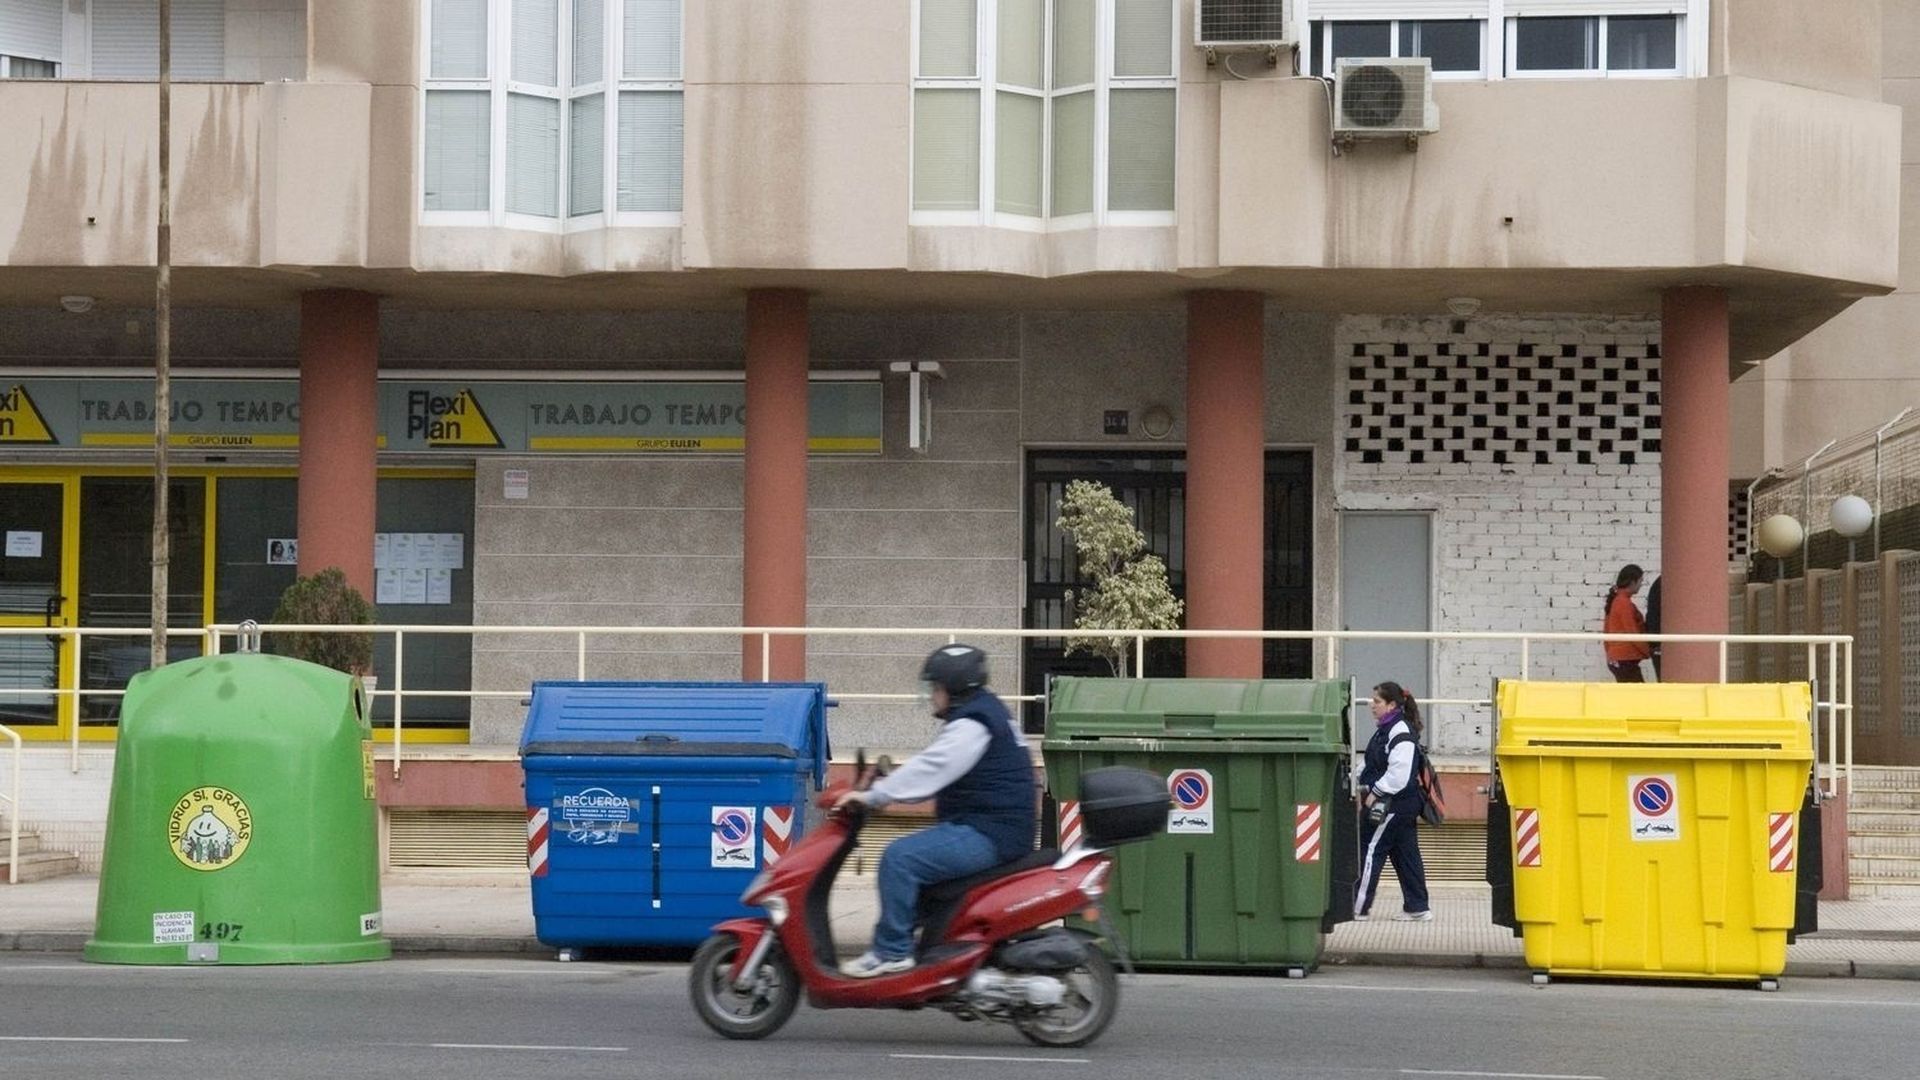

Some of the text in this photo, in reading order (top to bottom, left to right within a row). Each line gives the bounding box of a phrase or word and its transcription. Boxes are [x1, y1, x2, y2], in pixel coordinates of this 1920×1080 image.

[408, 390, 465, 415] Flexi
[530, 403, 652, 425] TRABAJO
[408, 415, 461, 439] Plan
[187, 435, 252, 445] GRUPO EULEN
[636, 439, 701, 448] GRUPO EULEN
[563, 796, 630, 808] RECUERDA
[170, 798, 191, 844] VIDRIO
[213, 789, 250, 840] GRACIAS
[199, 922, 244, 942] 497
